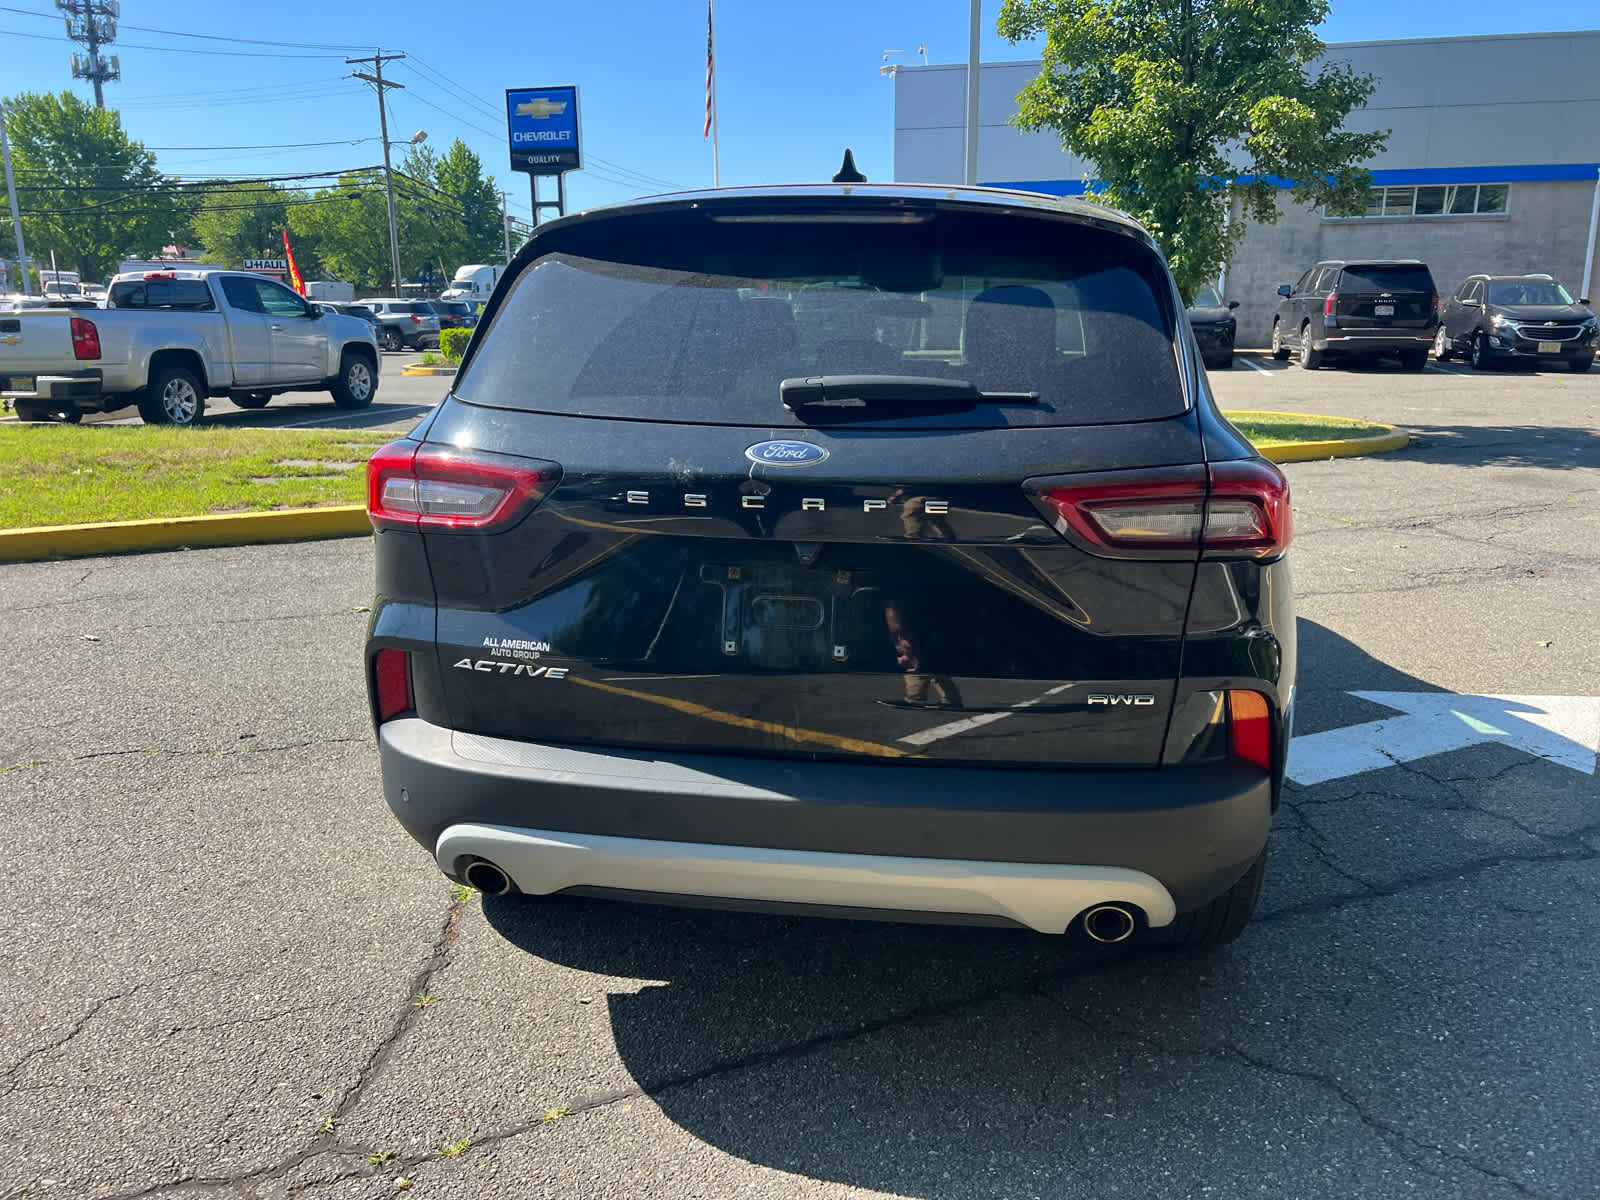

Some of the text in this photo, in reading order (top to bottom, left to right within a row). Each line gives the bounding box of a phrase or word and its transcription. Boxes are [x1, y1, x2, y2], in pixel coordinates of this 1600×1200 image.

[513, 131, 571, 142] CHEVROLET
[528, 155, 560, 164] QUALITY
[244, 260, 286, 269] U-HAUL
[763, 442, 808, 460] Ford
[626, 490, 949, 515] ESCAPE
[483, 637, 550, 652] ALL AMERICAN
[491, 648, 541, 660] AUTO GROUP
[453, 658, 569, 679] ACTIVE
[1087, 694, 1155, 705] AWD
